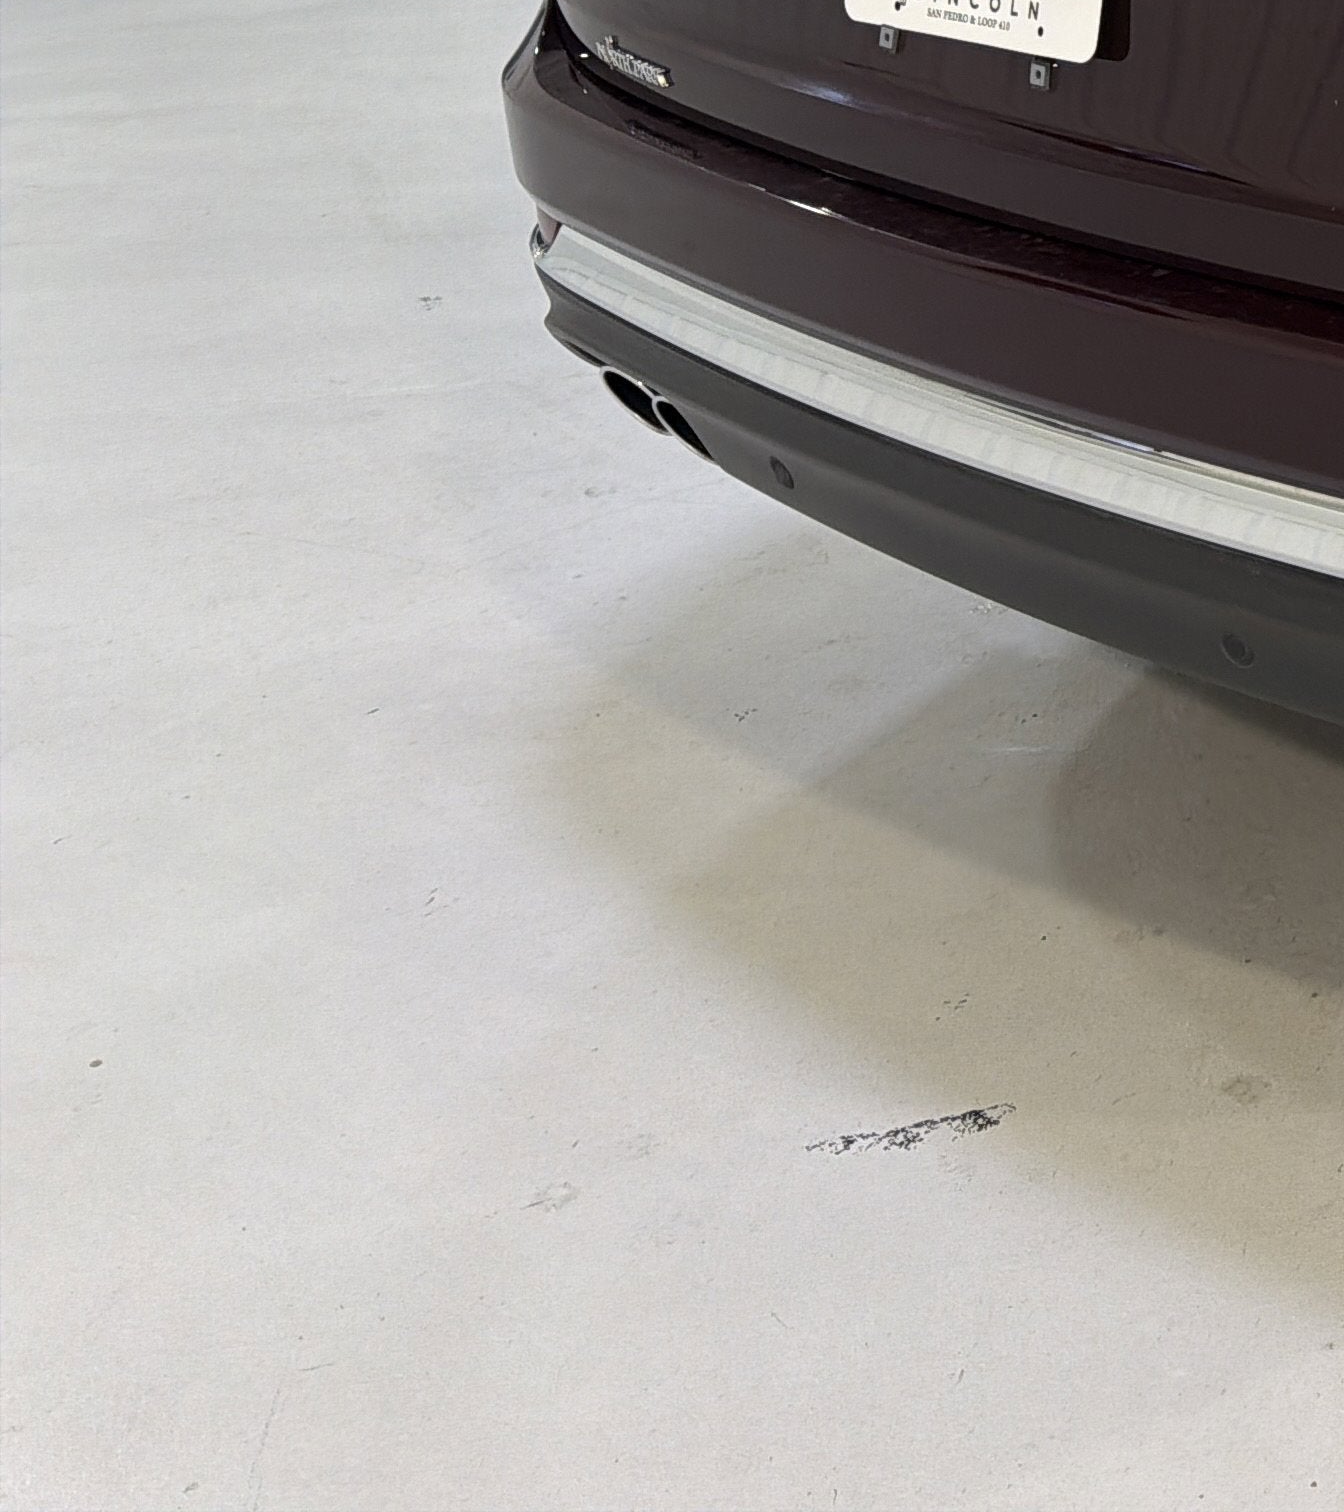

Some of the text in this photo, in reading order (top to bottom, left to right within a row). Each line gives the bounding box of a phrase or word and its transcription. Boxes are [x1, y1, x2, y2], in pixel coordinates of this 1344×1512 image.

[927, 7, 942, 19] SAN
[943, 9, 968, 24] PEDRO
[977, 16, 998, 30] LOOP
